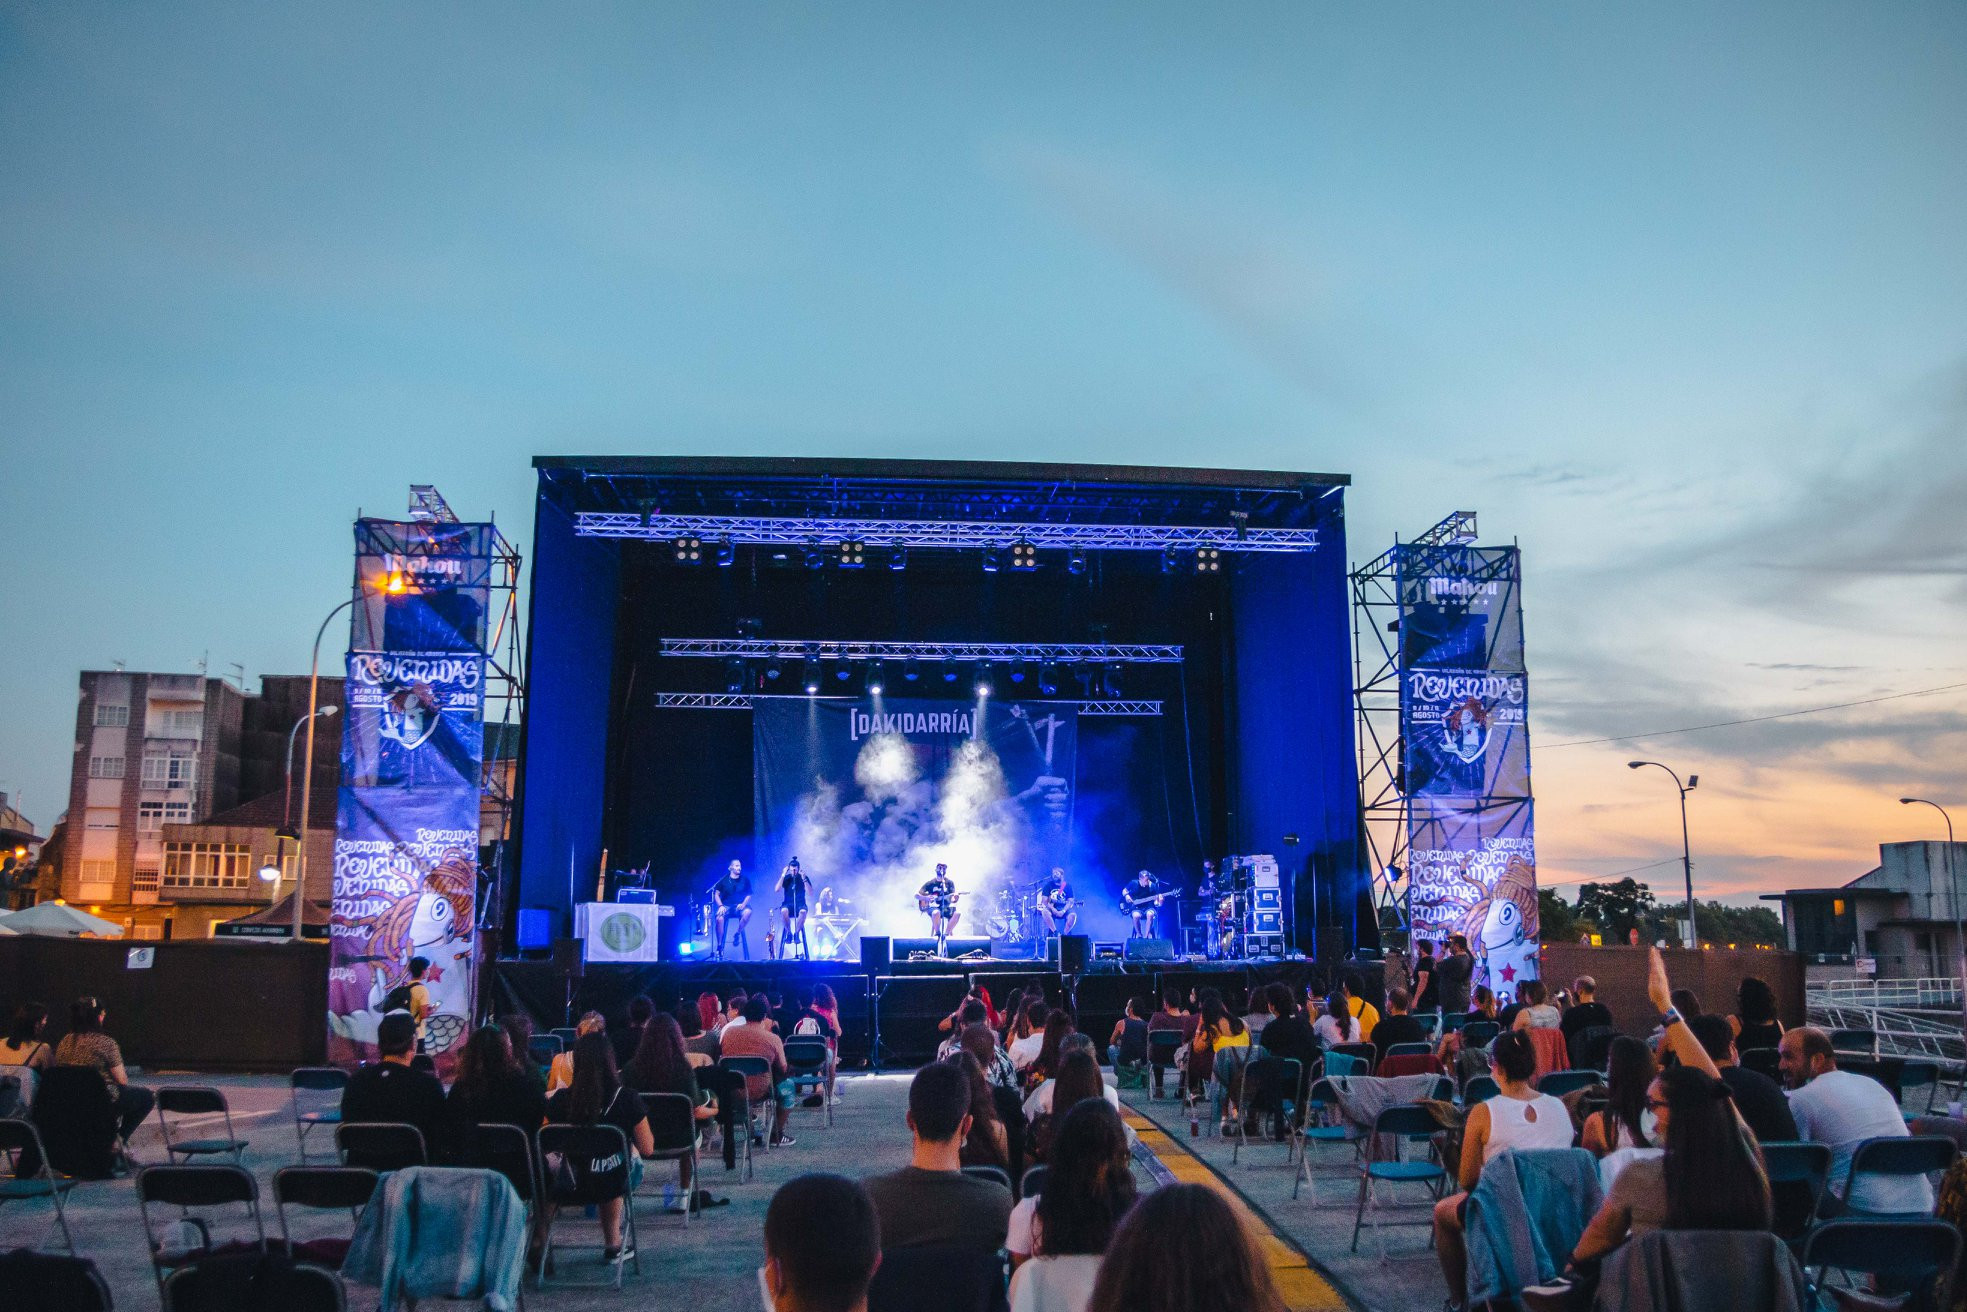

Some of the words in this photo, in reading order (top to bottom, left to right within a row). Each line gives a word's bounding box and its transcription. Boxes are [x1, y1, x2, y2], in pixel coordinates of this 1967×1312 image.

[1428, 577, 1498, 596] Mahou
[449, 693, 478, 706] 2019
[1412, 711, 1440, 719] AGOSTO
